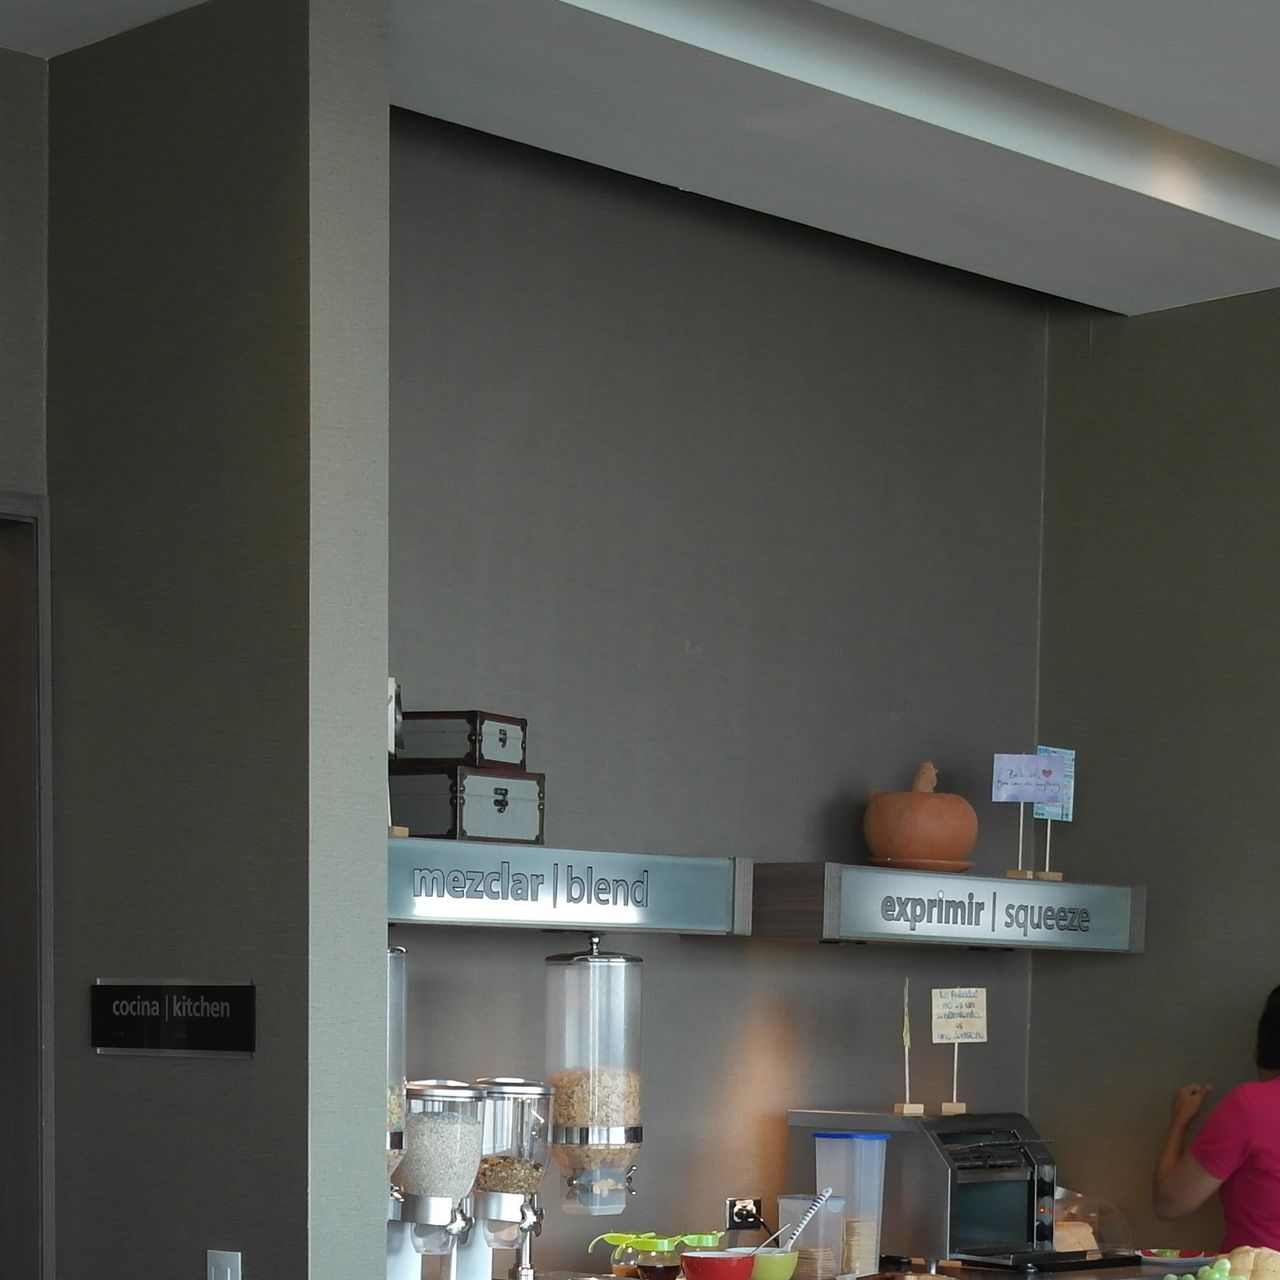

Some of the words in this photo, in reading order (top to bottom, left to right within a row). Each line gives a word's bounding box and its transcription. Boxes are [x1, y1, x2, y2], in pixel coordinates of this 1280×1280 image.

[413, 861, 544, 902] mezclar
[566, 864, 649, 908] blend
[880, 890, 985, 931] exprimir
[1004, 902, 1091, 937] squeeze
[112, 995, 160, 1017] cocina
[172, 995, 231, 1018] kitchen
